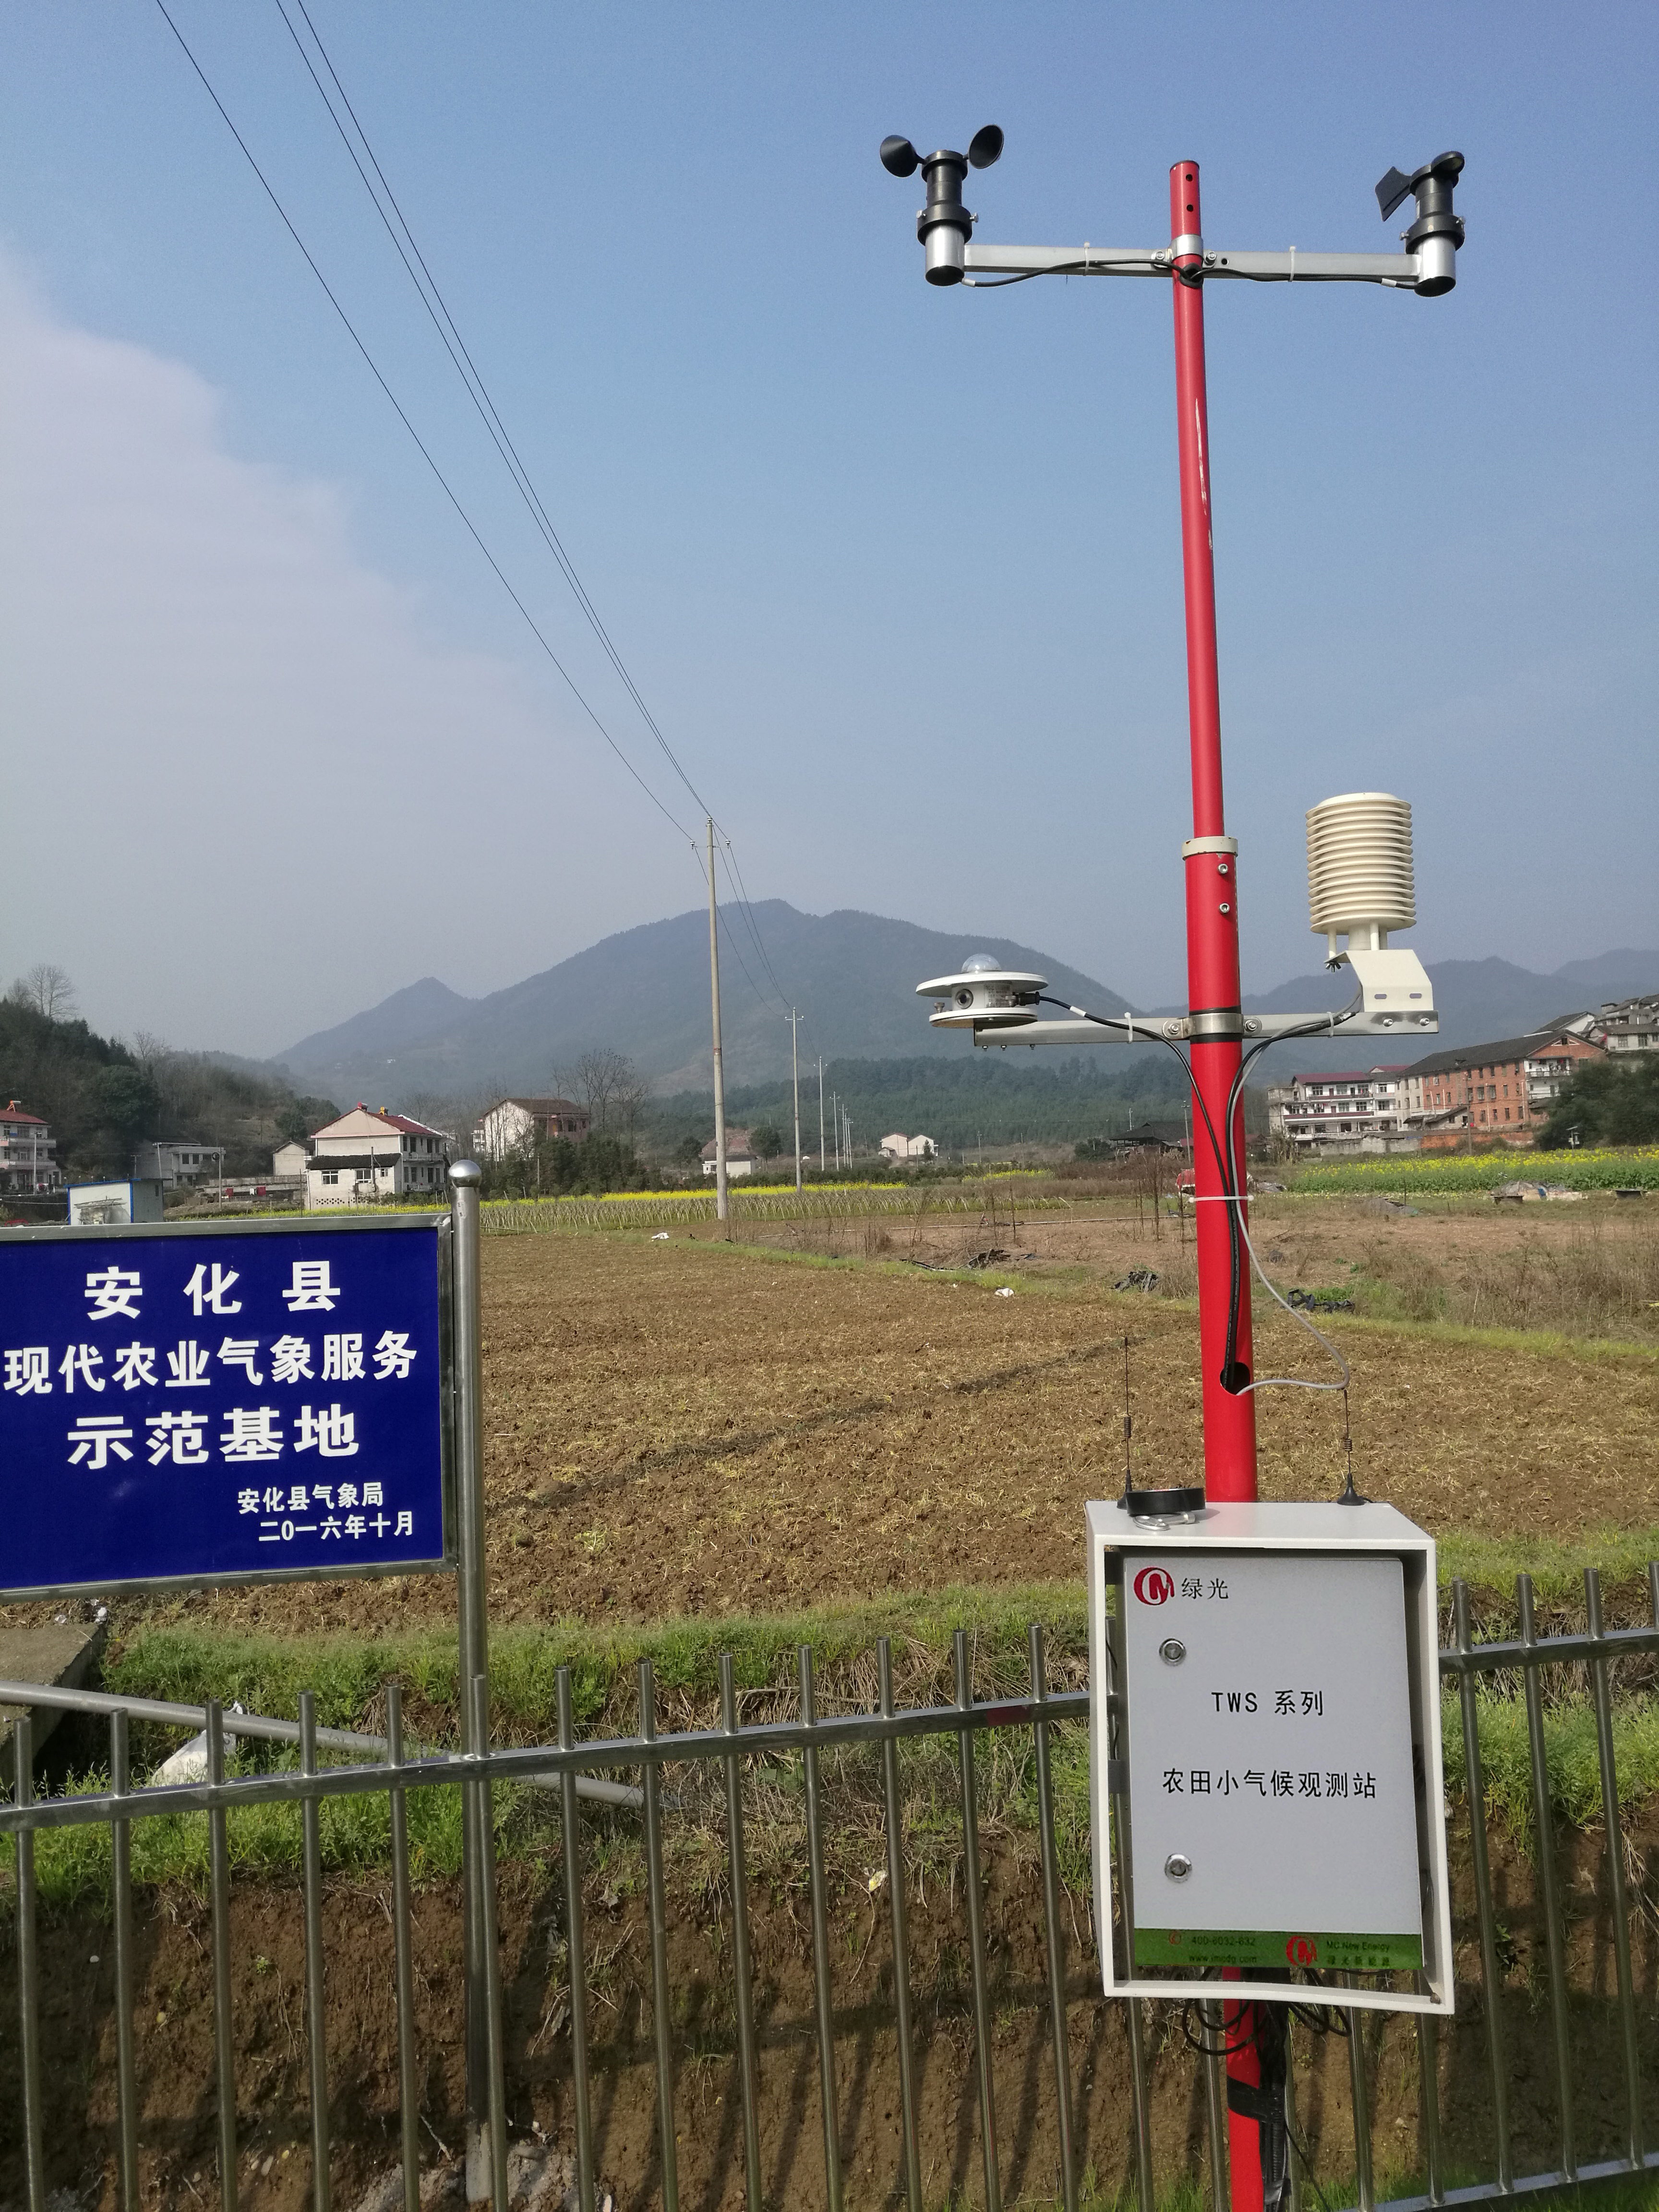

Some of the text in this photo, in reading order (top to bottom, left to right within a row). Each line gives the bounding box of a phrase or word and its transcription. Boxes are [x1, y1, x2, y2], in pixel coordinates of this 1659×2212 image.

[3, 1330, 417, 1395] 现代农业气象服务
[67, 1404, 359, 1470] 示范基地
[238, 1482, 383, 1515] 安化县气象局
[1181, 1577, 1229, 1599] 绿光
[1211, 1689, 1323, 1716] TWS 系列
[1162, 1767, 1376, 1799] 农田小气候观测站
